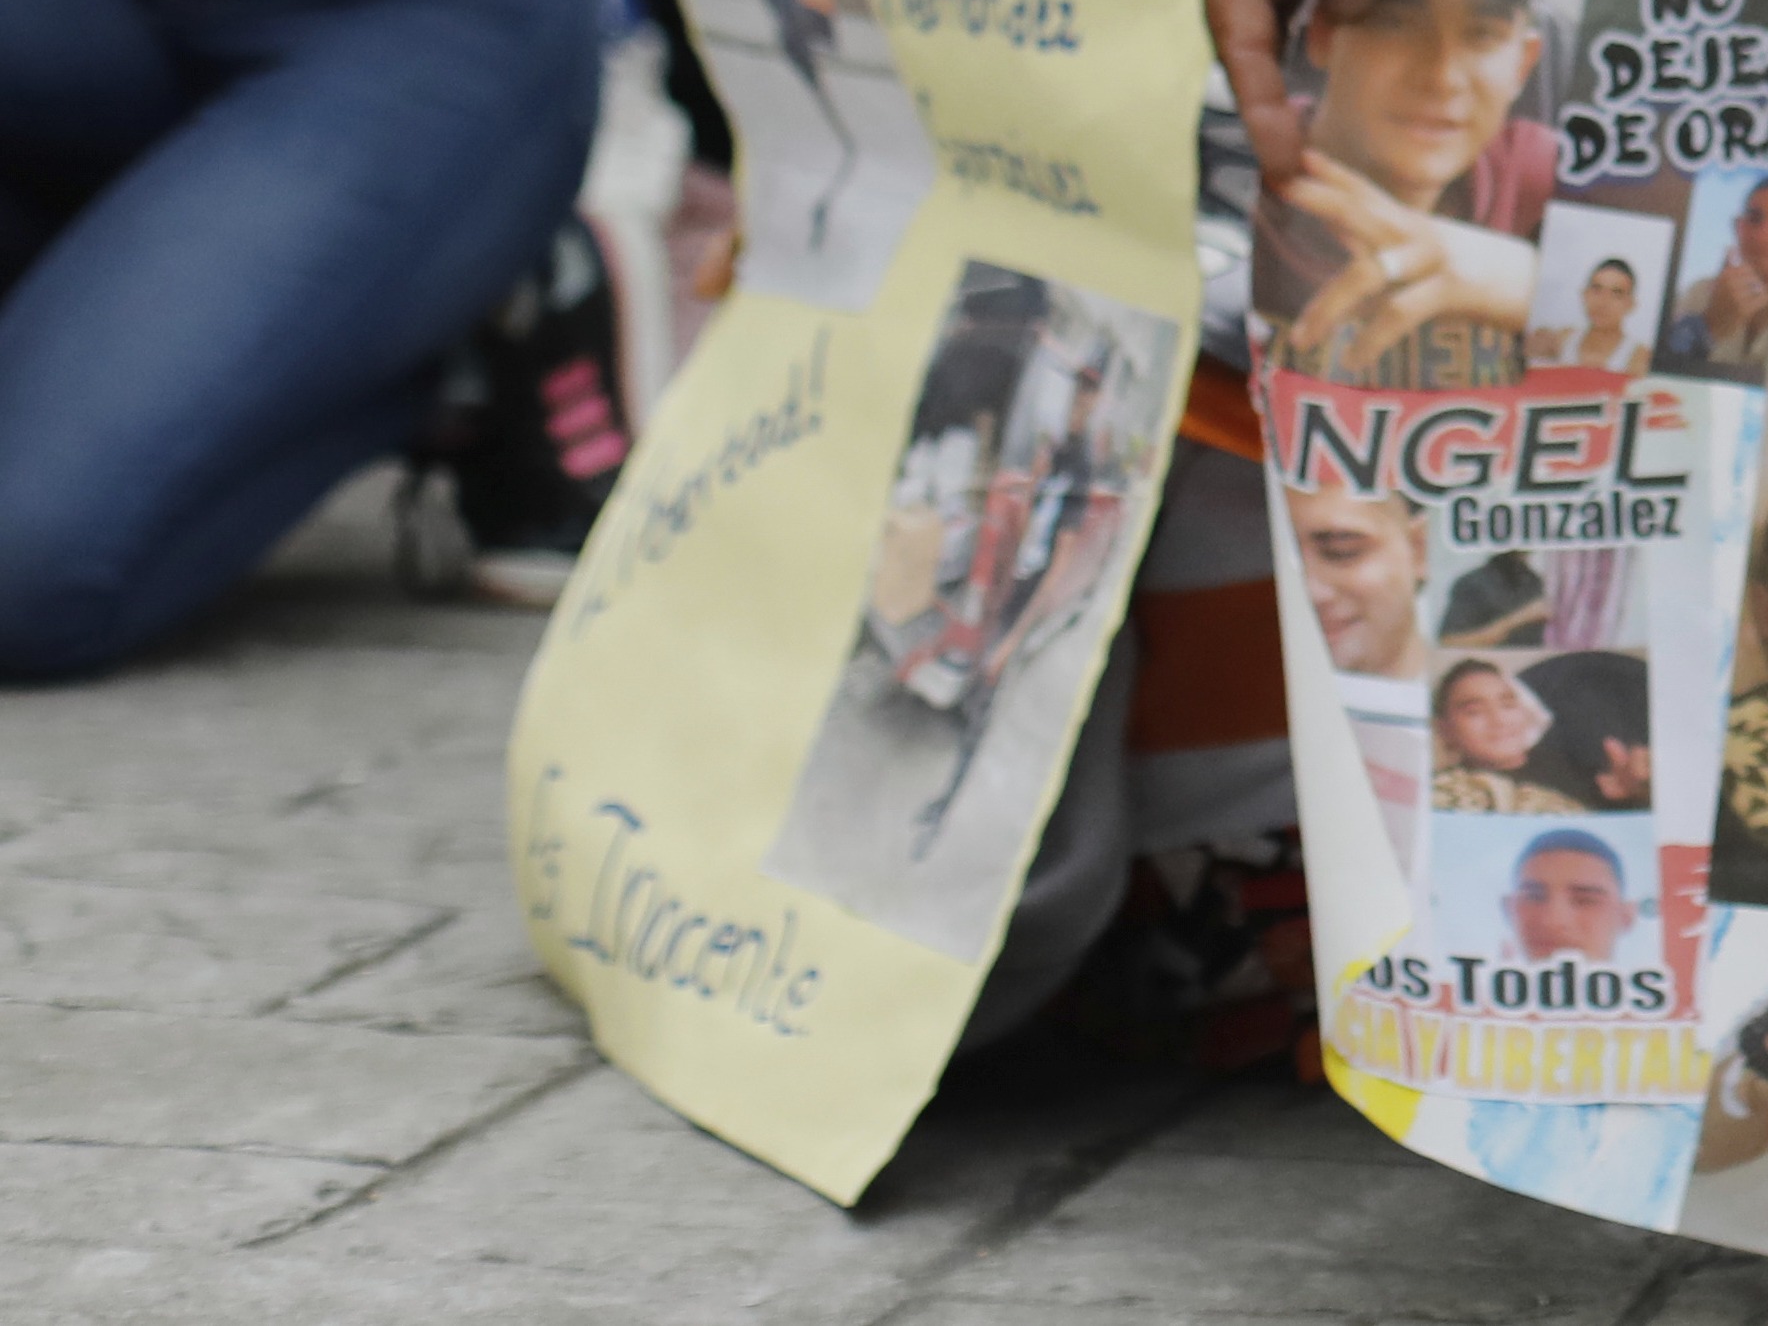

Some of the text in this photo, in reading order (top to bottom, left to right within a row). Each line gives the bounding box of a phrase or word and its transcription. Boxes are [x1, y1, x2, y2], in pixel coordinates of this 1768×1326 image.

[1562, 110, 1648, 176] DE
[1450, 490, 1683, 546] González
[1450, 955, 1667, 1011] Todos
